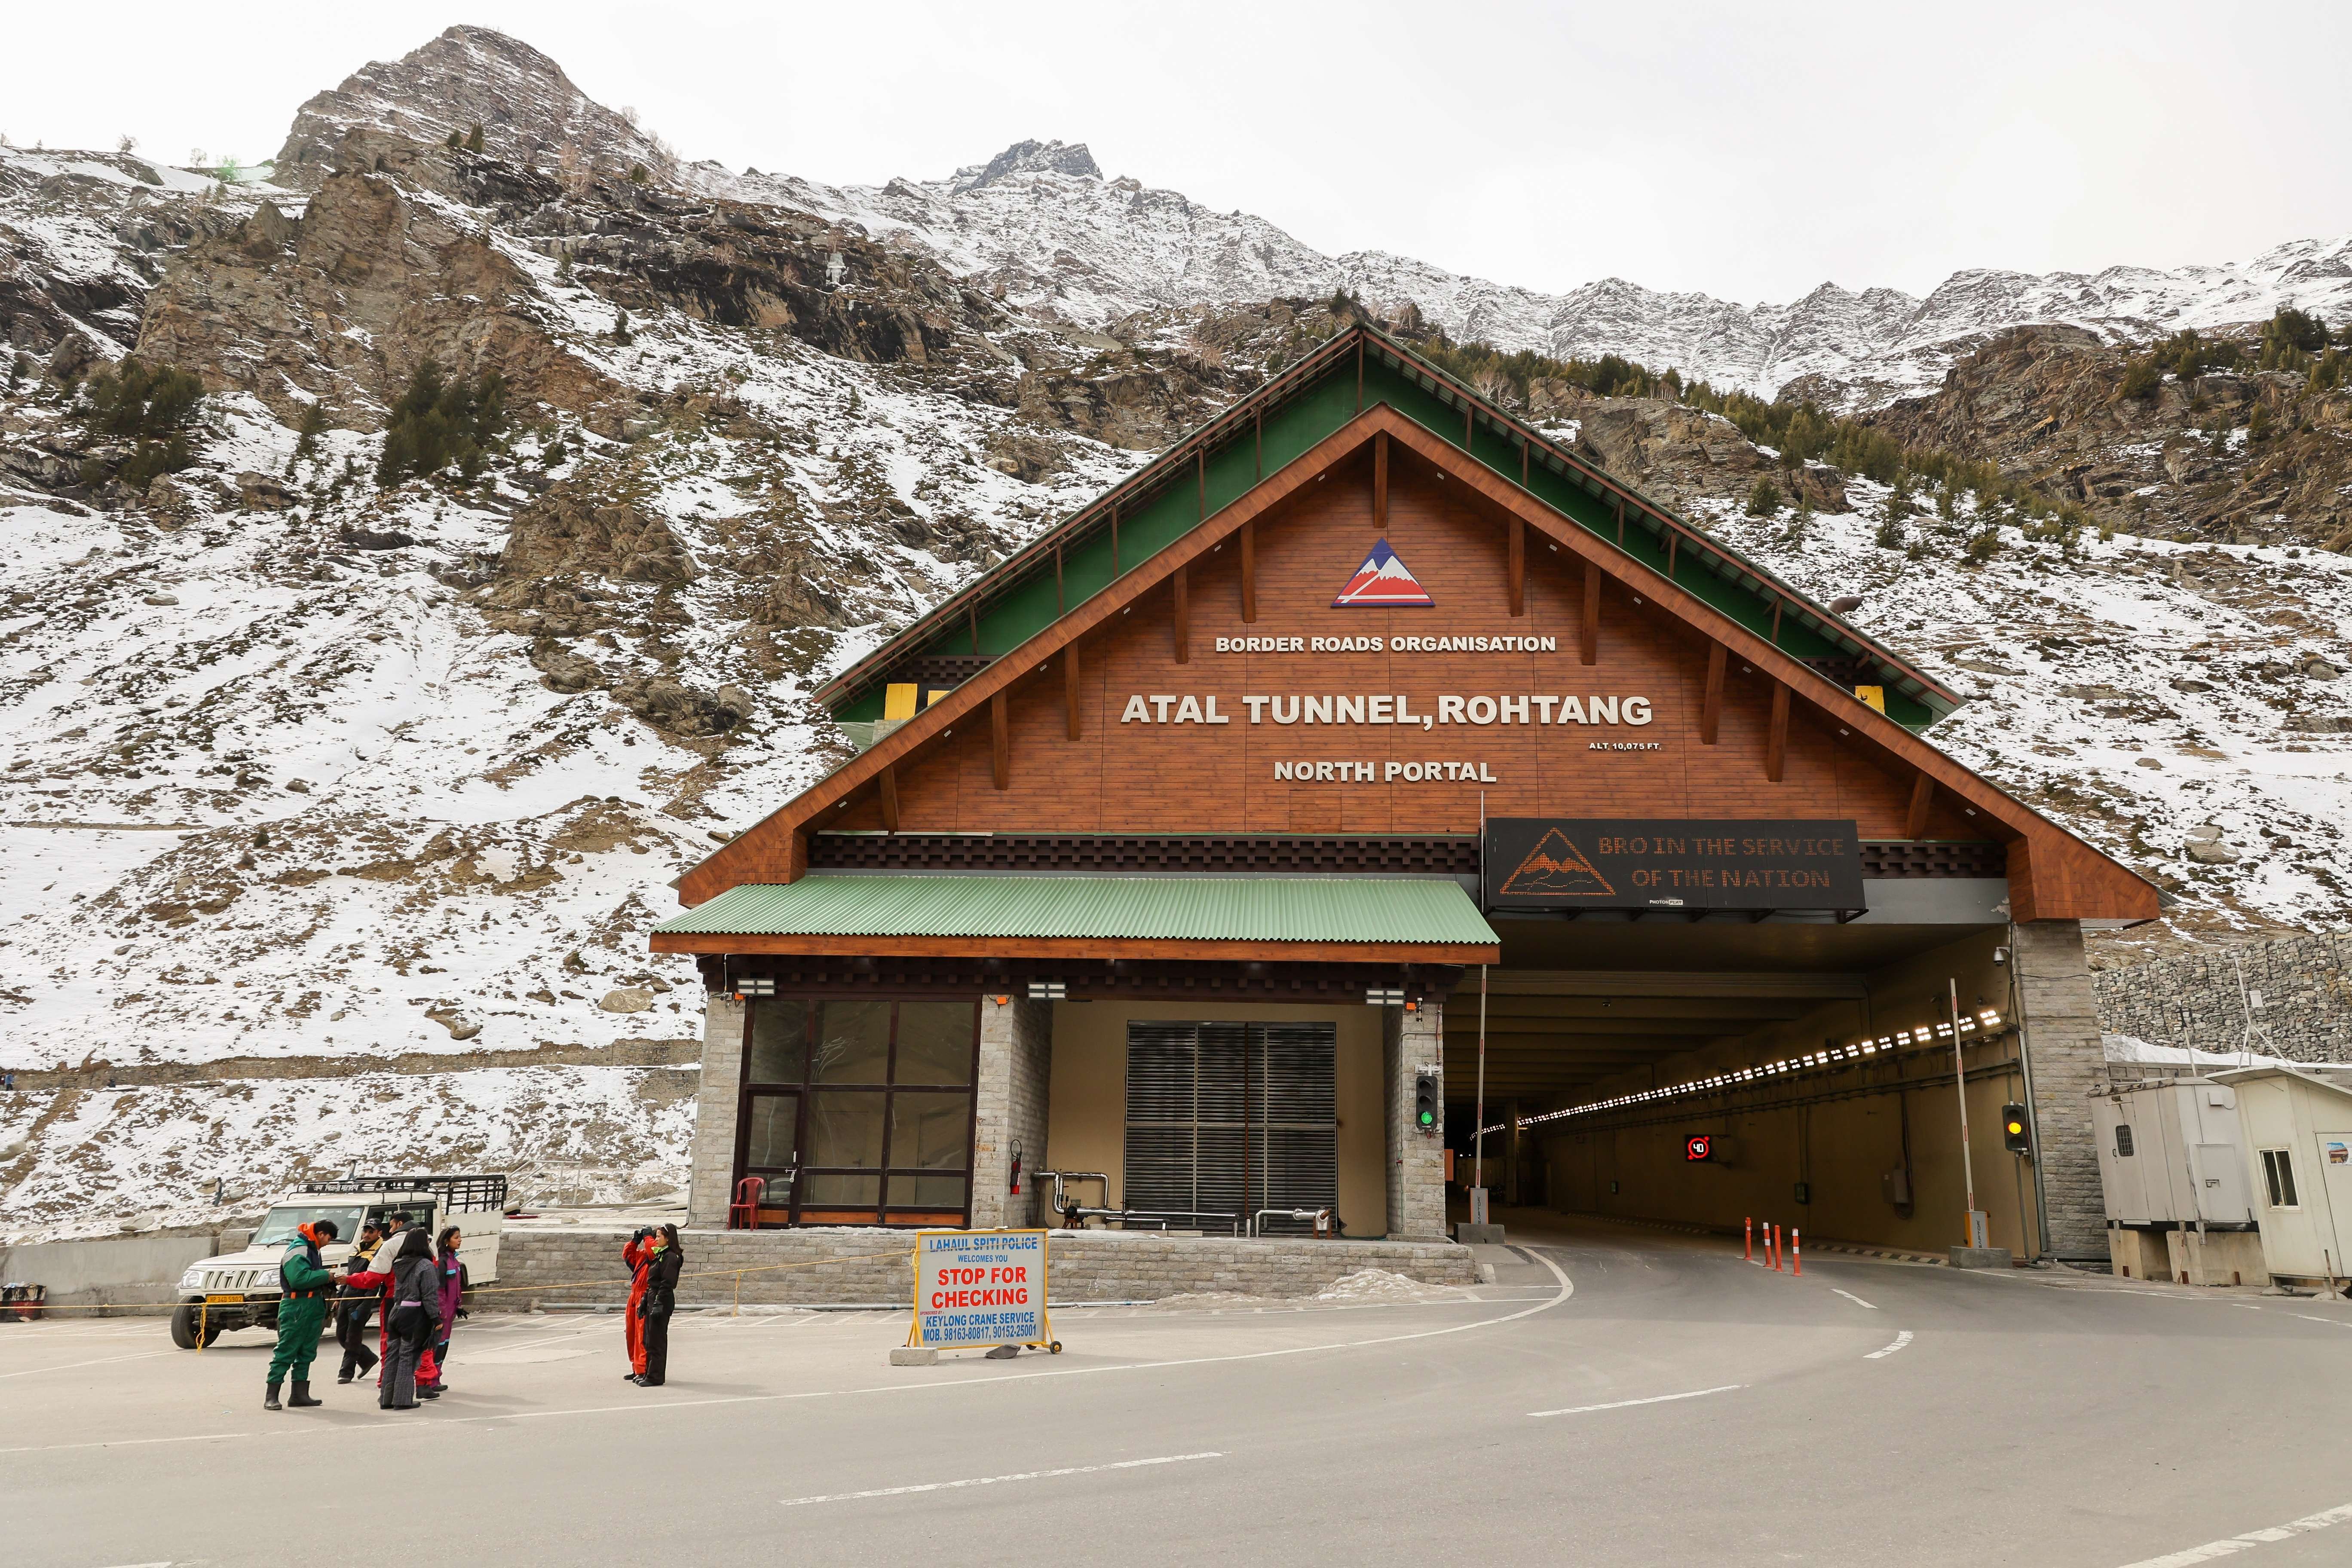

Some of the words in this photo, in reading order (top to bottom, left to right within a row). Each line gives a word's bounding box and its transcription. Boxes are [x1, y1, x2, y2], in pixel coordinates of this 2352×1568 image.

[1216, 637, 1305, 652] BORDER
[1311, 637, 1383, 651] ROADS
[1390, 637, 1556, 651] ORGANISATION
[1121, 695, 1229, 723] ATAL
[1274, 762, 1374, 781] NORTH
[1385, 762, 1497, 782] PORTAL
[1599, 837, 1648, 854] BRO
[1653, 837, 1685, 854] IN
[1692, 839, 1736, 855] THE
[1742, 839, 1845, 855] SERVICE
[1632, 870, 1662, 886] OF
[1668, 870, 1714, 887] THE
[1721, 870, 1830, 887] NATION
[1693, 1143, 1704, 1152] 40
[930, 1238, 970, 1252] LAHAUL
[973, 1237, 999, 1251] SPITI
[1002, 1237, 1037, 1250] POLICE
[938, 1268, 986, 1286] STOP
[991, 1267, 1027, 1283] FOR
[931, 1288, 1028, 1309] CHECKING
[926, 1314, 966, 1327] KEYLONG
[969, 1313, 997, 1326] CRANE
[999, 1312, 1034, 1324] SERVICE
[923, 1327, 943, 1341] MOB.
[944, 1326, 991, 1341] 98163-80817,
[993, 1323, 1036, 1338] 90152-25001
